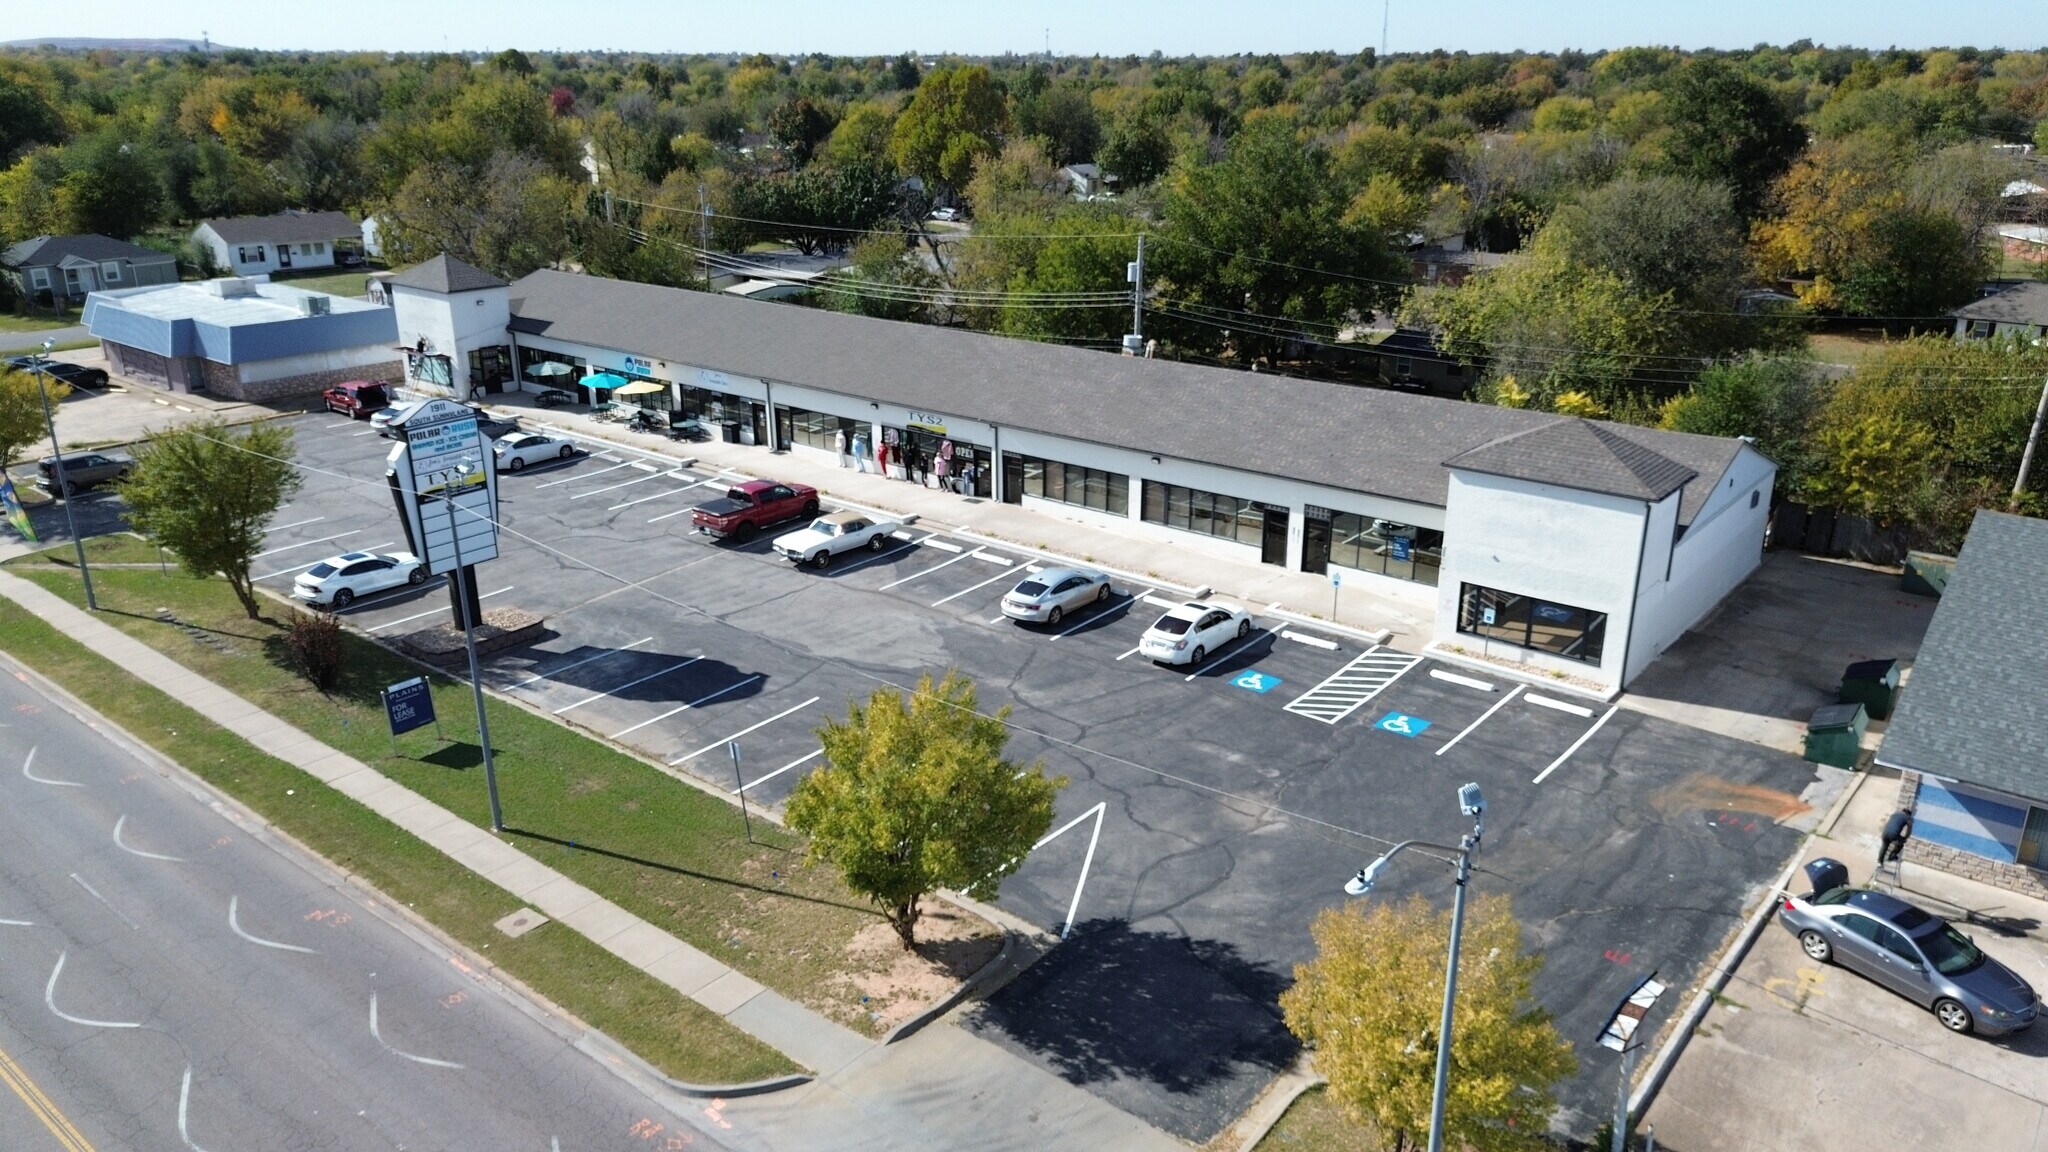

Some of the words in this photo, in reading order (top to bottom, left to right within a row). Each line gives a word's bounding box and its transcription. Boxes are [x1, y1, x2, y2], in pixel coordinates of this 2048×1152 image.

[431, 403, 446, 412] 1911
[410, 416, 431, 426] SOUTH
[432, 409, 469, 421] SUNNYLANE
[908, 412, 943, 426] TYS2
[409, 428, 440, 442] POLAR
[451, 420, 476, 433] RUSH
[389, 684, 425, 700] PLAINS
[392, 702, 408, 713] FOR
[393, 706, 416, 721] LEASE
